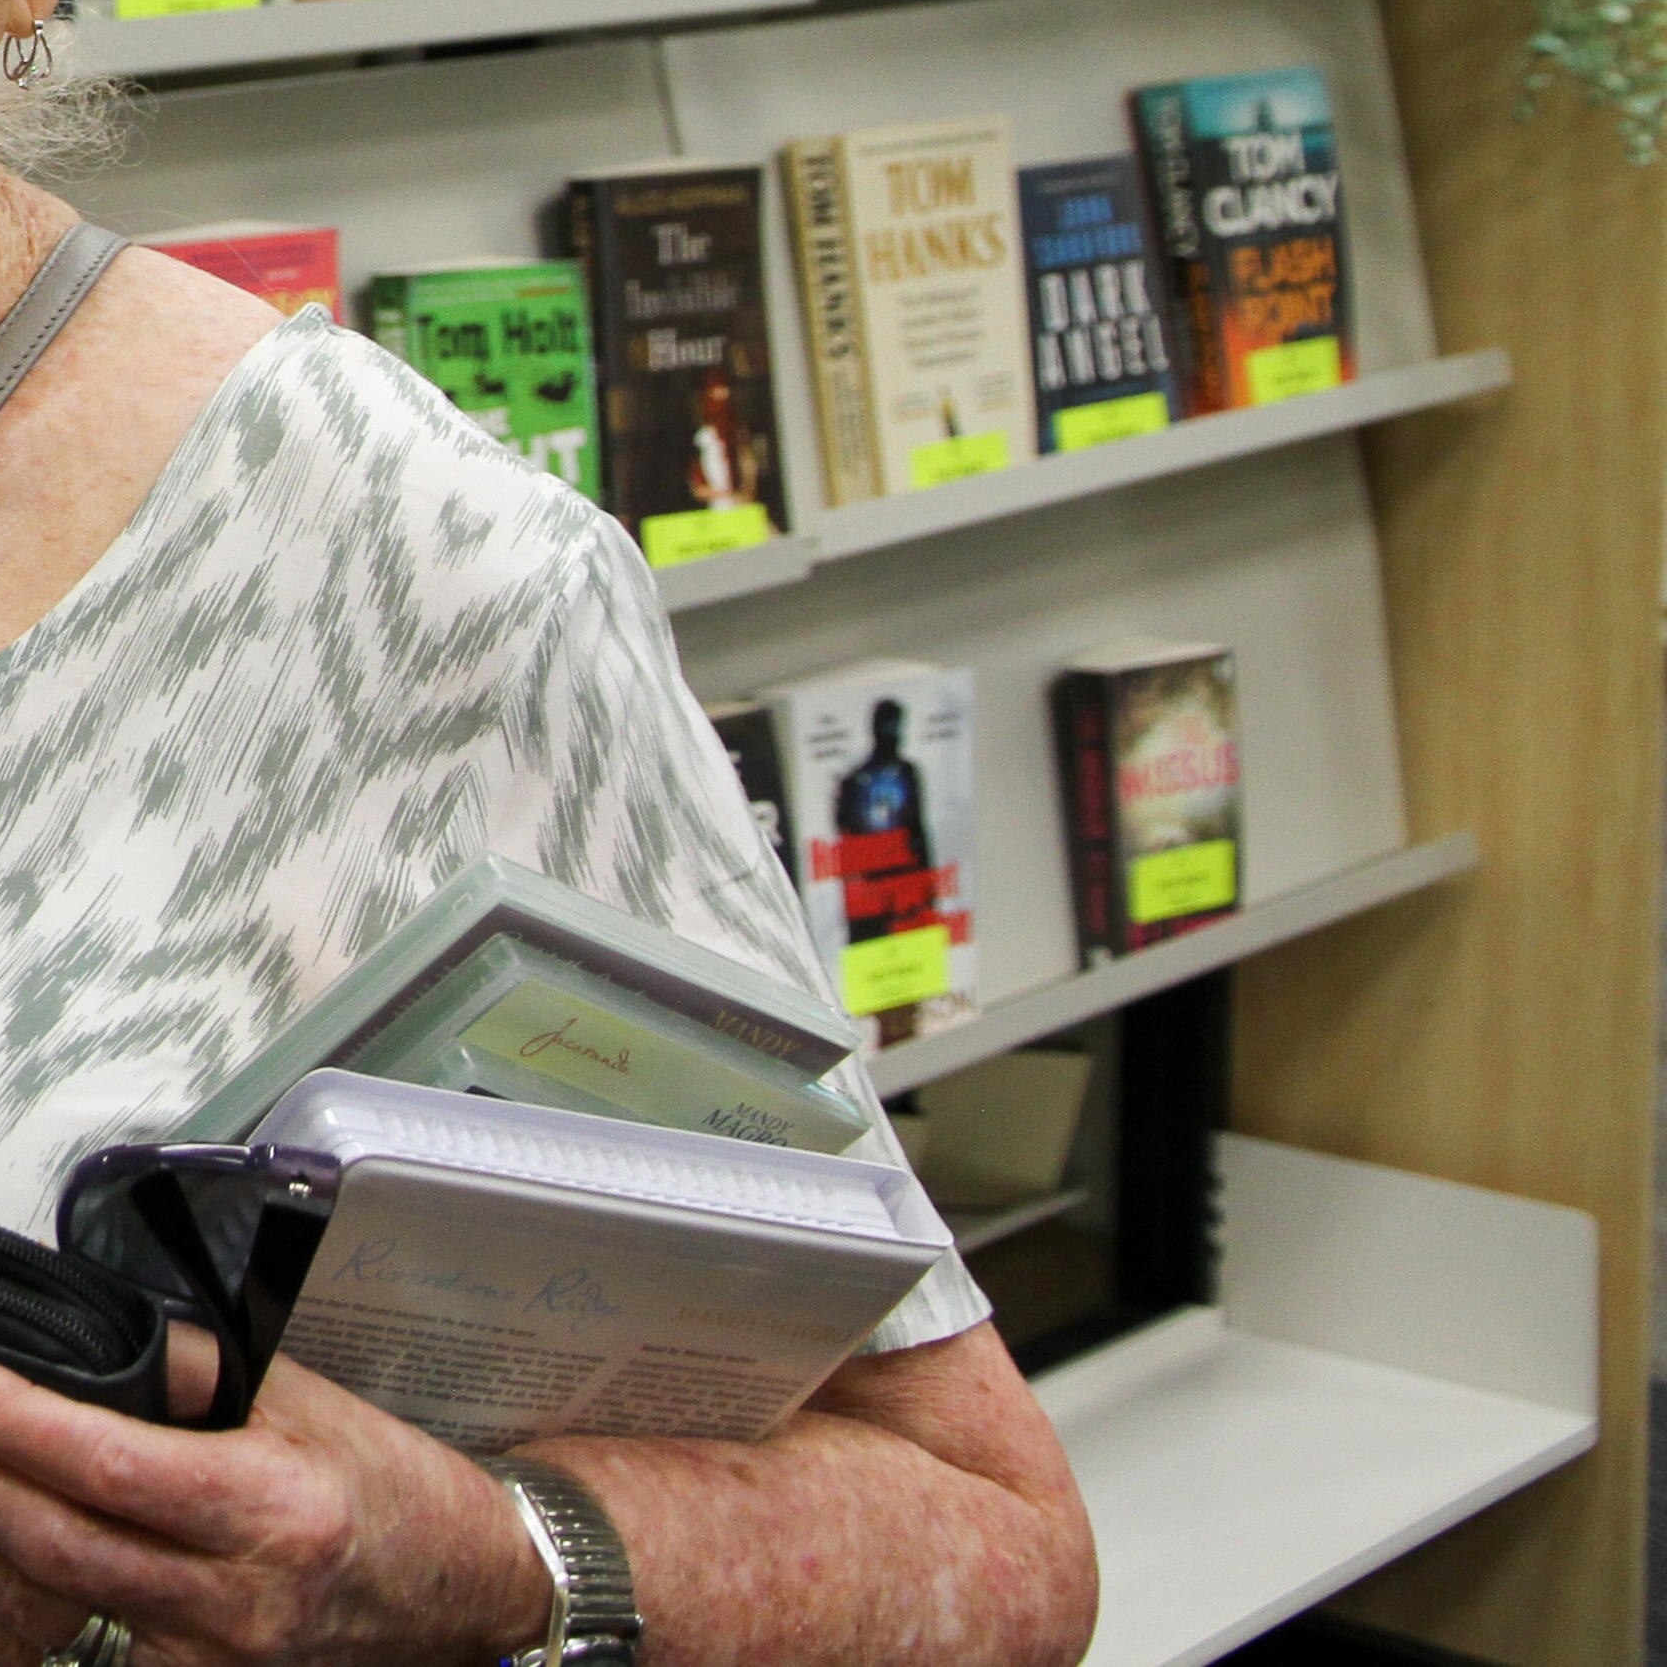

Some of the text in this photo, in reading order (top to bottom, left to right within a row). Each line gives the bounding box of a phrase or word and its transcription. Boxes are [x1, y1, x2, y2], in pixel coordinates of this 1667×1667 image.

[1221, 129, 1306, 183] TOM
[885, 153, 977, 217] TOM
[1202, 171, 1339, 238] CLANCY
[653, 221, 712, 266] The
[865, 209, 1008, 282] HANKS
[1038, 259, 1152, 334] DARK
[417, 312, 490, 362] Tom
[501, 307, 579, 354] Holt
[647, 326, 727, 373] Hour
[1037, 312, 1170, 393] ANGEL
[714, 1010, 804, 1059] MANDY
[734, 1101, 794, 1134] MANDY
